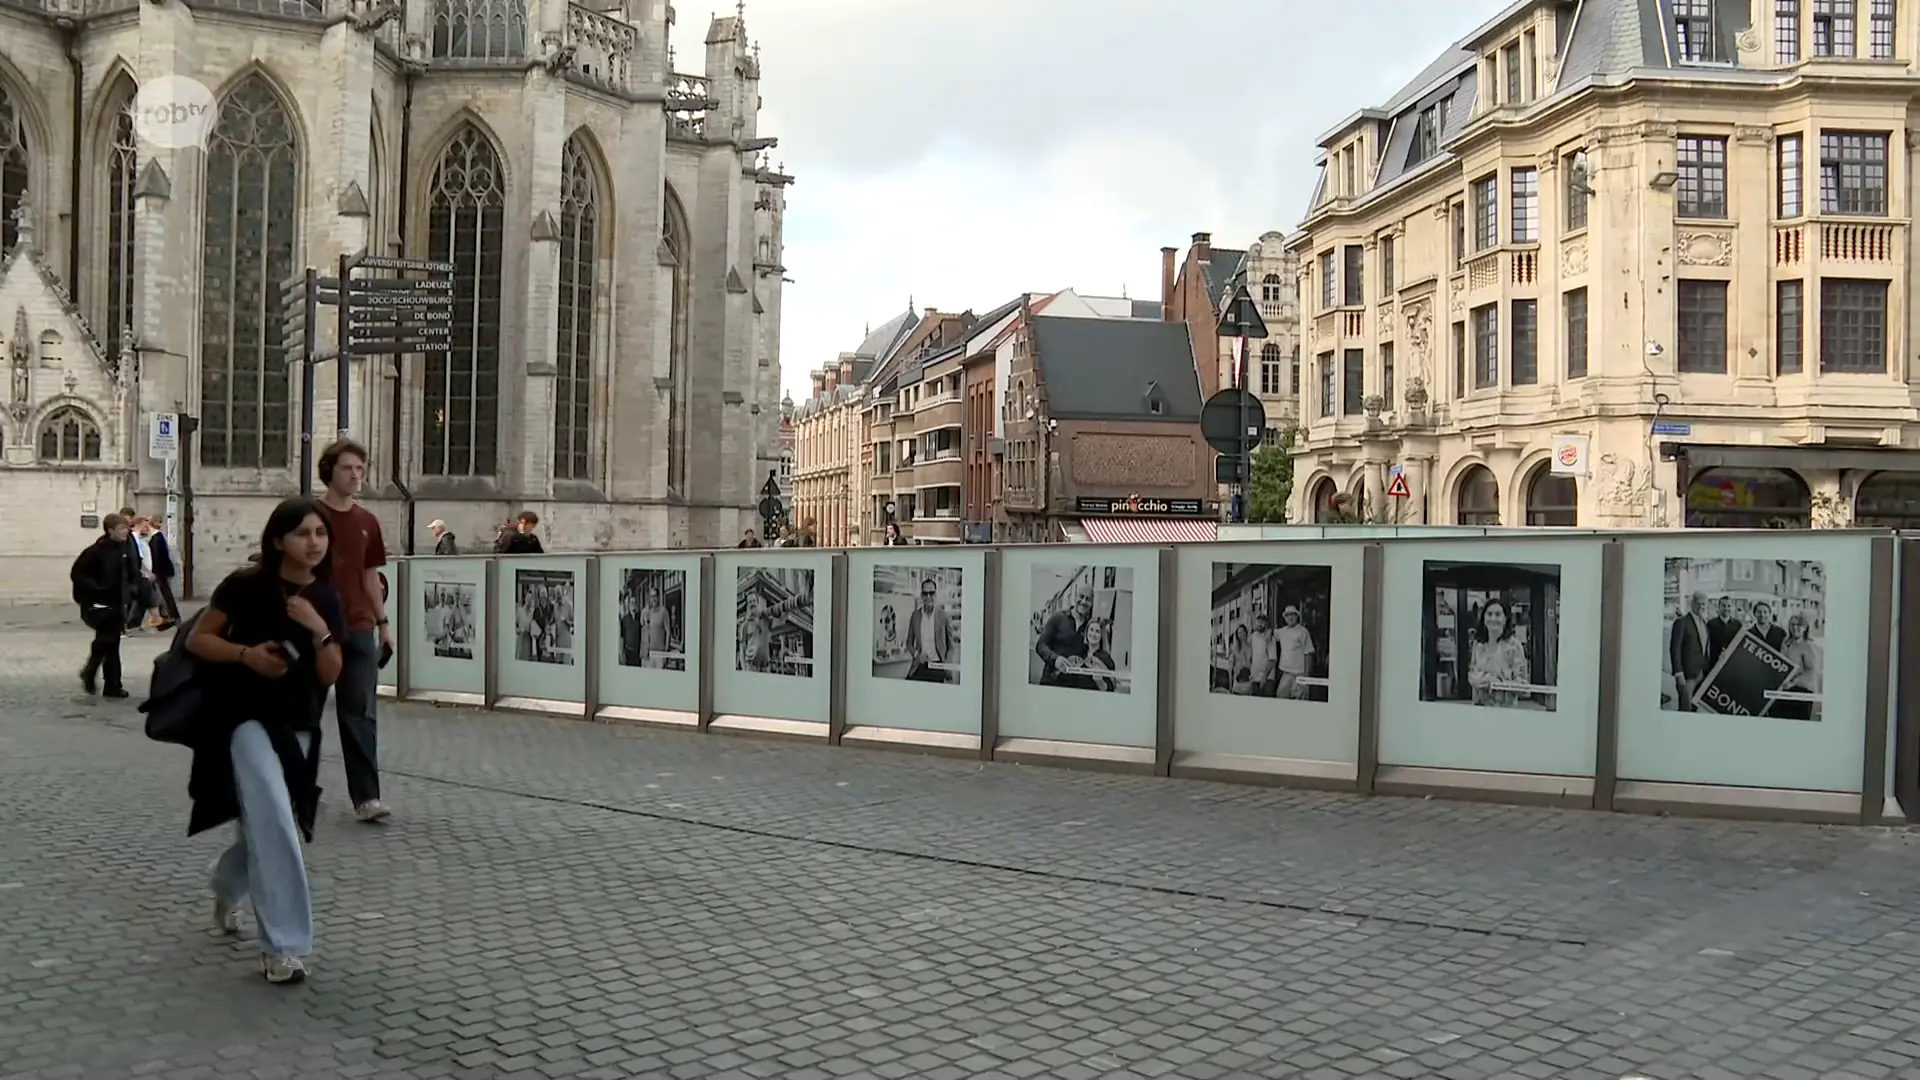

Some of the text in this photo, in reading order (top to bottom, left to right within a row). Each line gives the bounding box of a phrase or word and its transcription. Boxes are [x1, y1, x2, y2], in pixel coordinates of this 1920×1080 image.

[415, 281, 452, 289] LADEUZE
[414, 312, 450, 320] DE BOND
[418, 327, 450, 336] CENTER
[415, 343, 450, 351] STATION
[1755, 648, 1789, 674] KOOP
